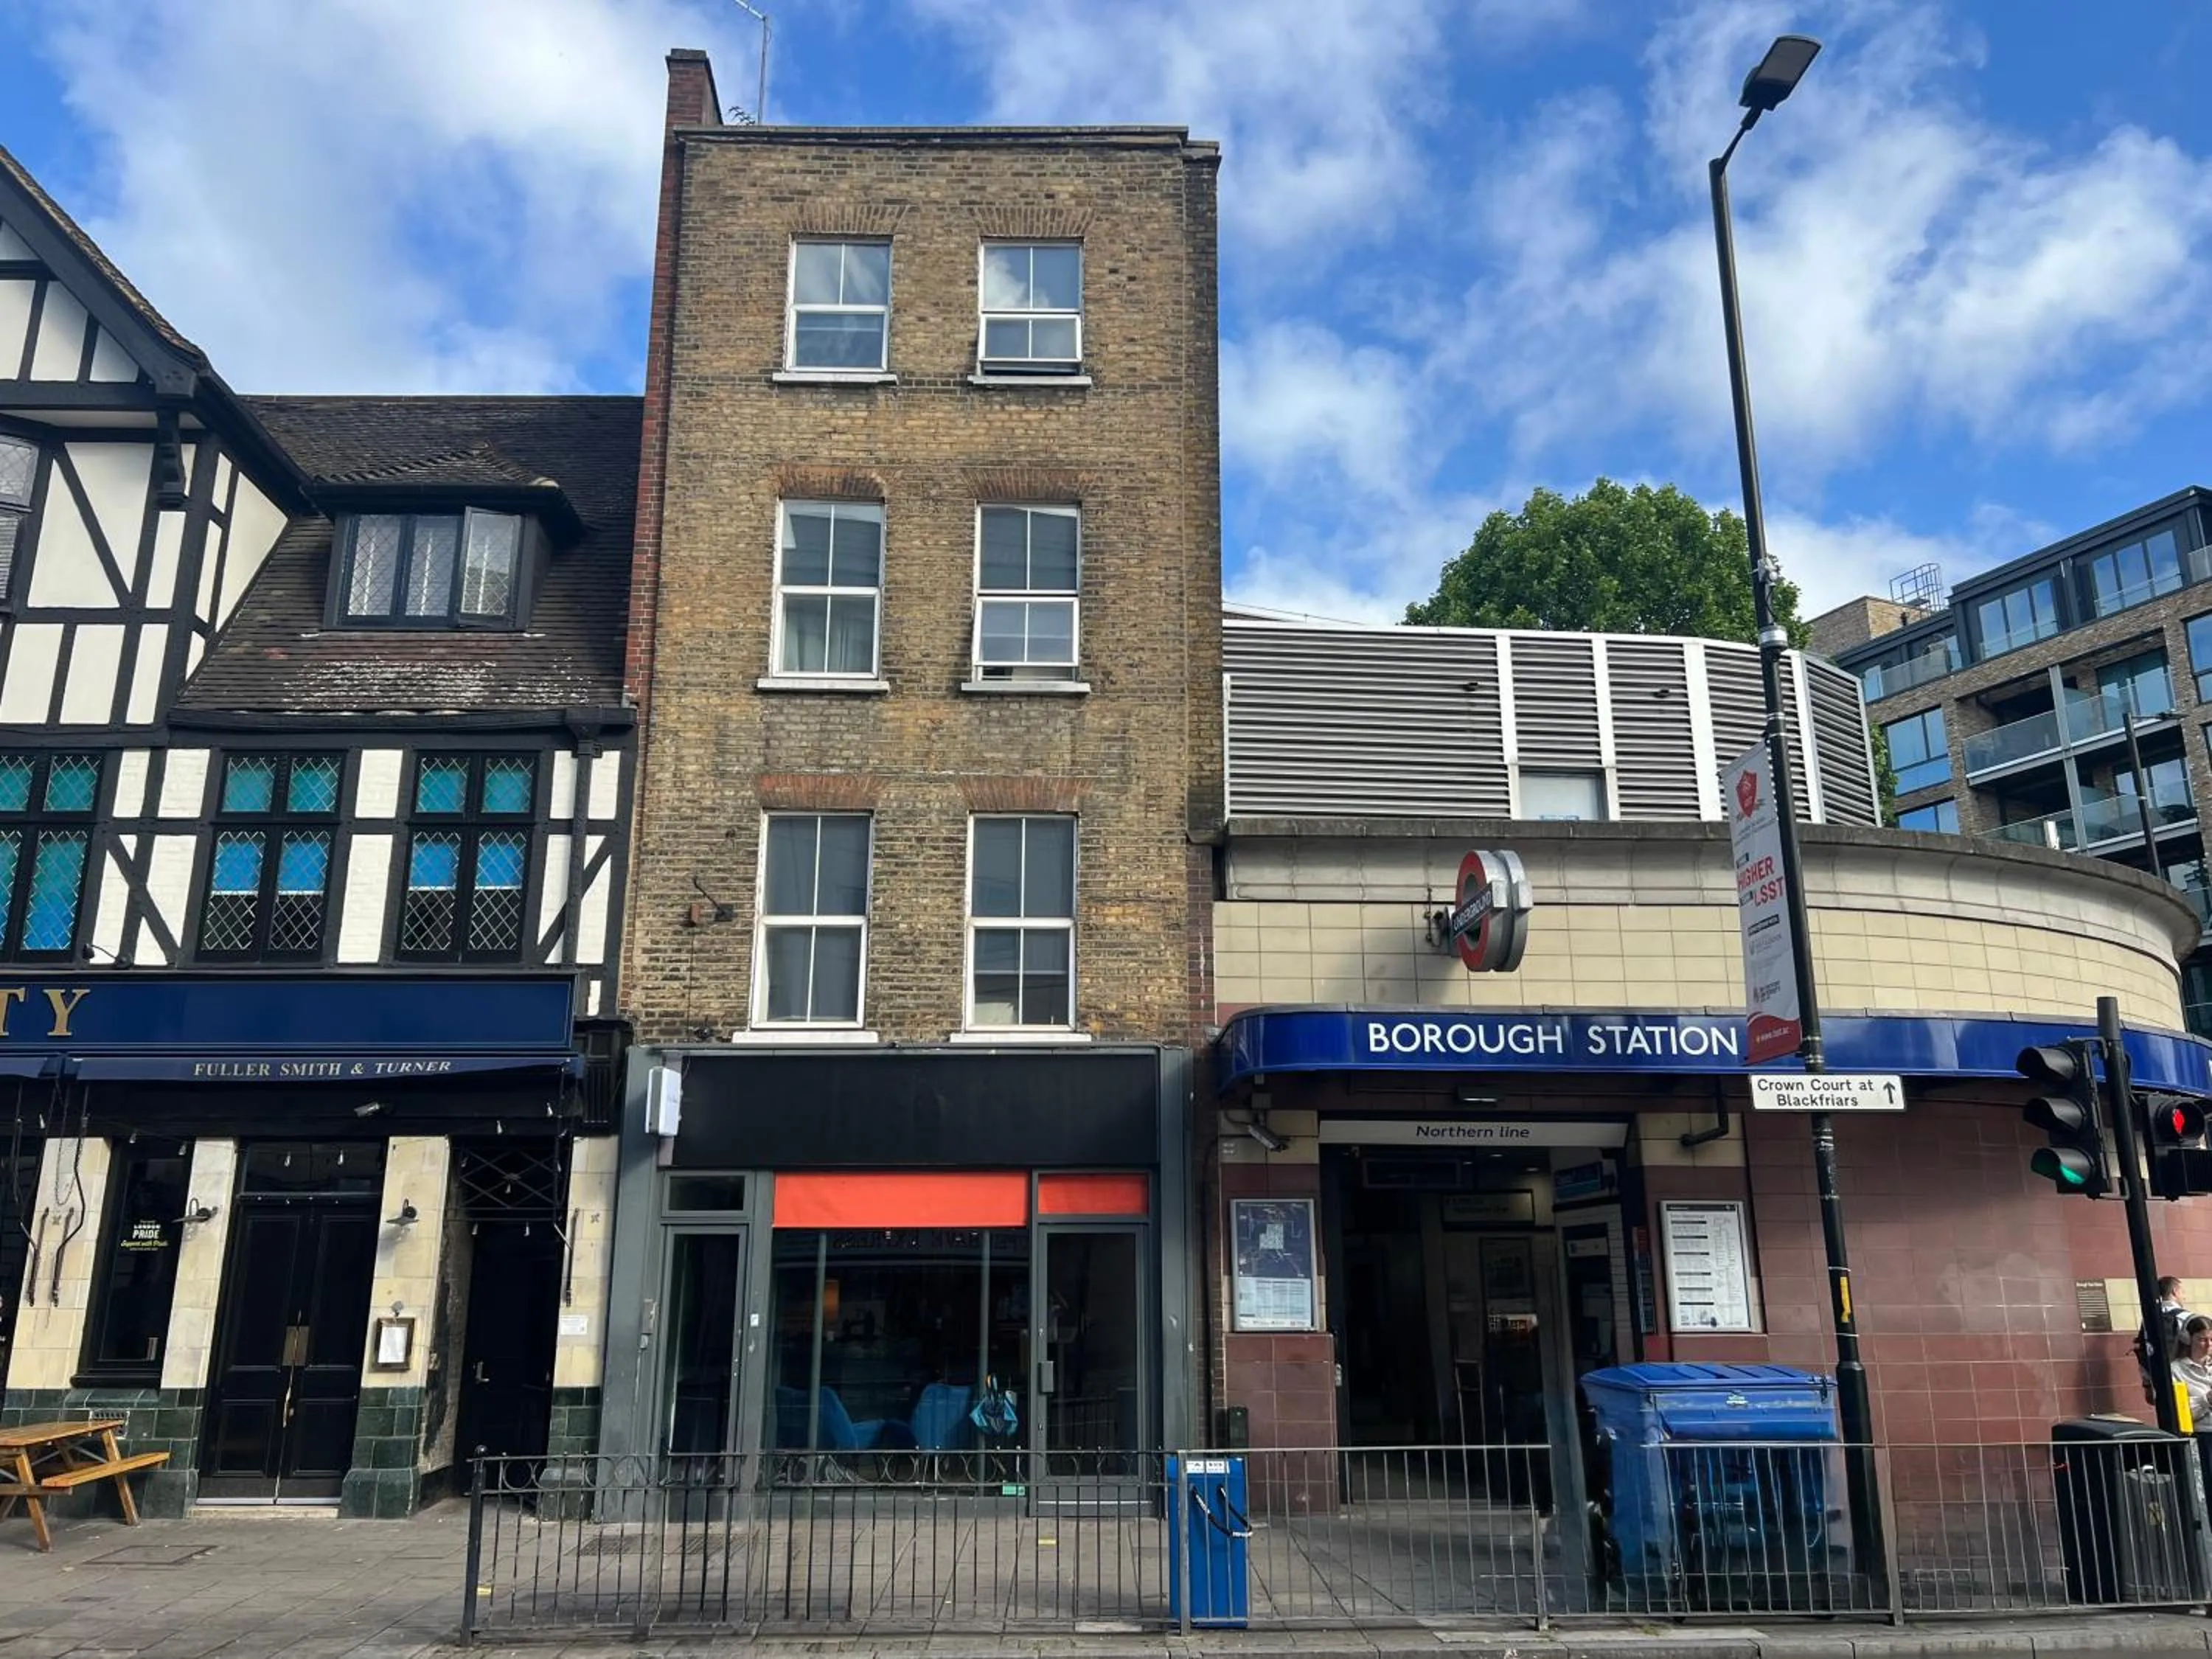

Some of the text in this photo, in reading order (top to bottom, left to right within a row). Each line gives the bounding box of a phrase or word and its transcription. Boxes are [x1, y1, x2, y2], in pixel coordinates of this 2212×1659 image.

[1754, 875, 1784, 907] LSST
[1368, 1023, 1739, 1056] BOROUGH STATION
[193, 1060, 452, 1077] FULLER SMITH & TURNER
[1757, 1079, 1874, 1091] Crown Court at
[1776, 1093, 1859, 1107] Blackfriars
[1415, 1124, 1531, 1139] Northern line
[132, 1229, 160, 1239] PRIDE
